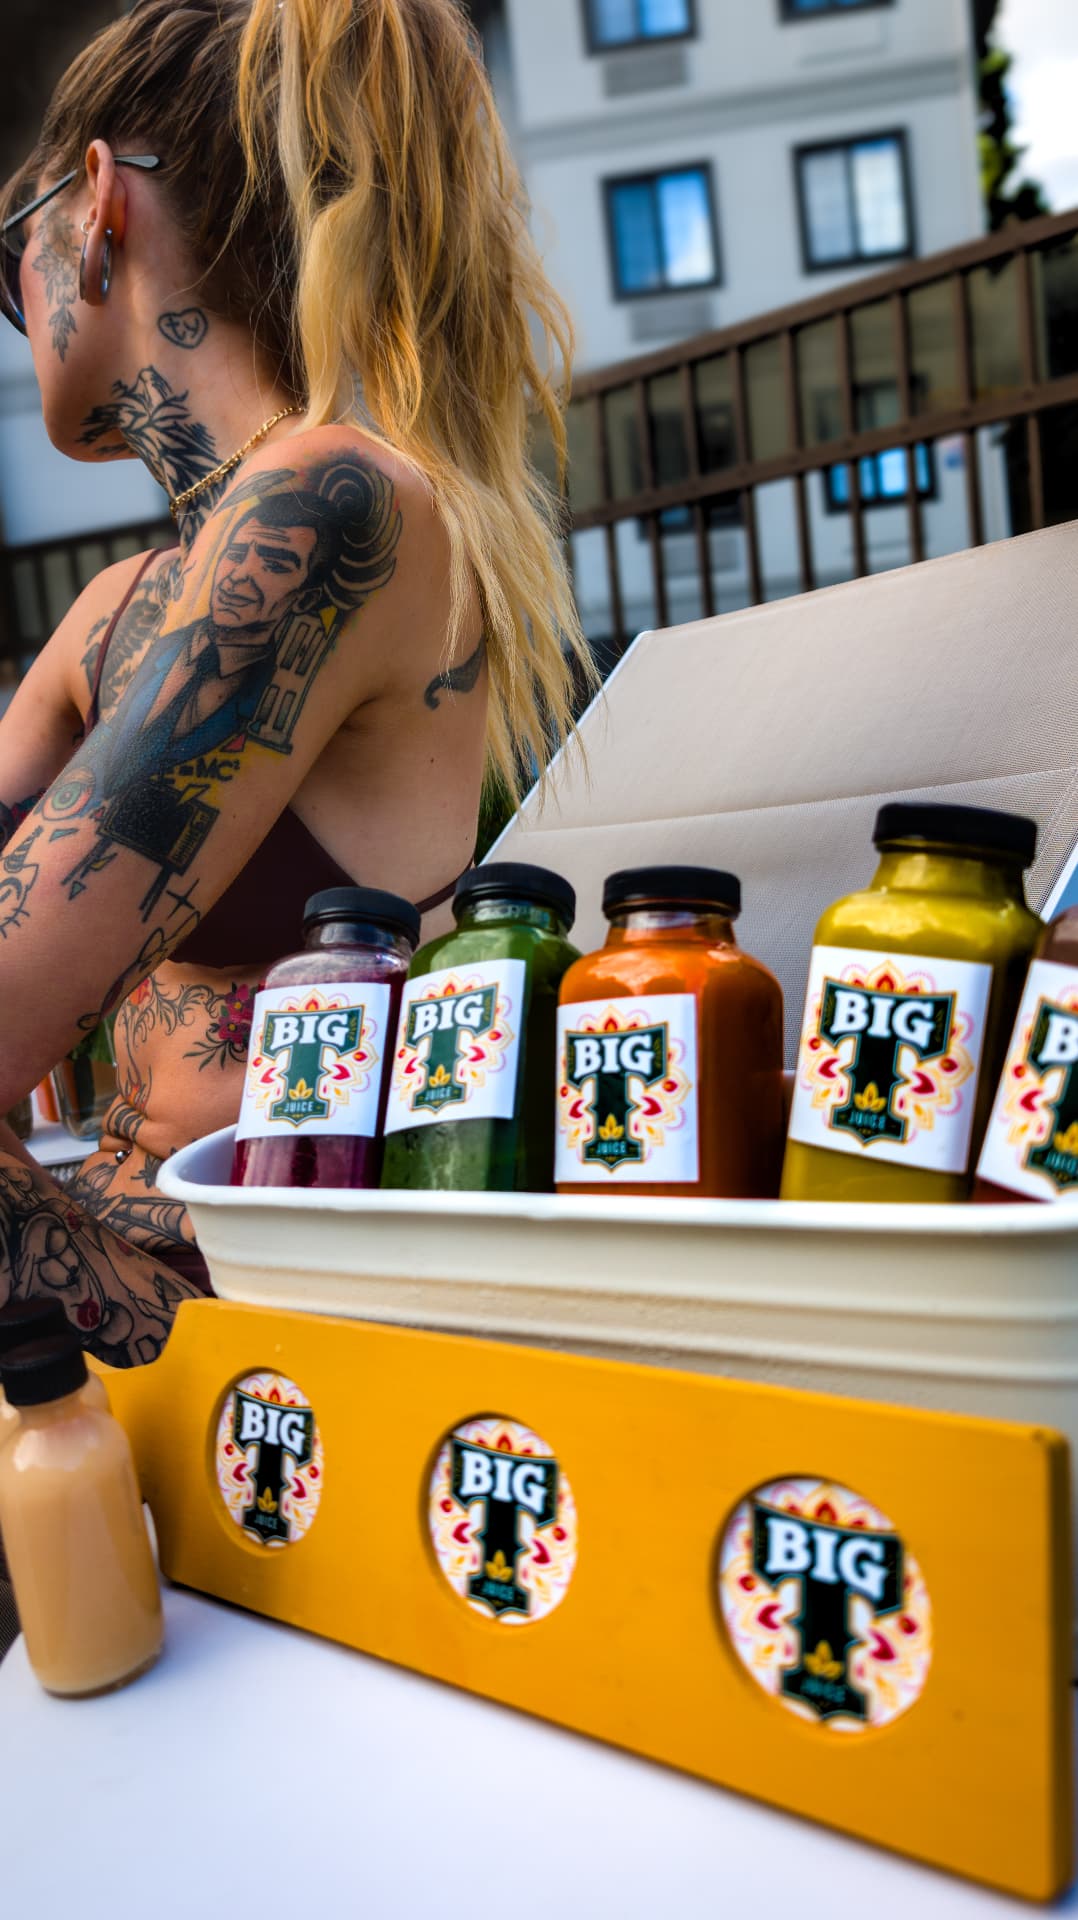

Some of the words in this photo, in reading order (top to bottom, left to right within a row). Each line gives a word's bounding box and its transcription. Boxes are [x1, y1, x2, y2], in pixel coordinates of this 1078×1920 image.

[269, 1012, 350, 1051] BIG
[412, 993, 484, 1041] BIG
[830, 990, 935, 1048] BIG
[573, 1034, 655, 1080] BIG
[283, 1101, 314, 1113] JUICE
[239, 1400, 307, 1457] BIG
[460, 1448, 548, 1517] BIG
[764, 1515, 890, 1602] BIG
